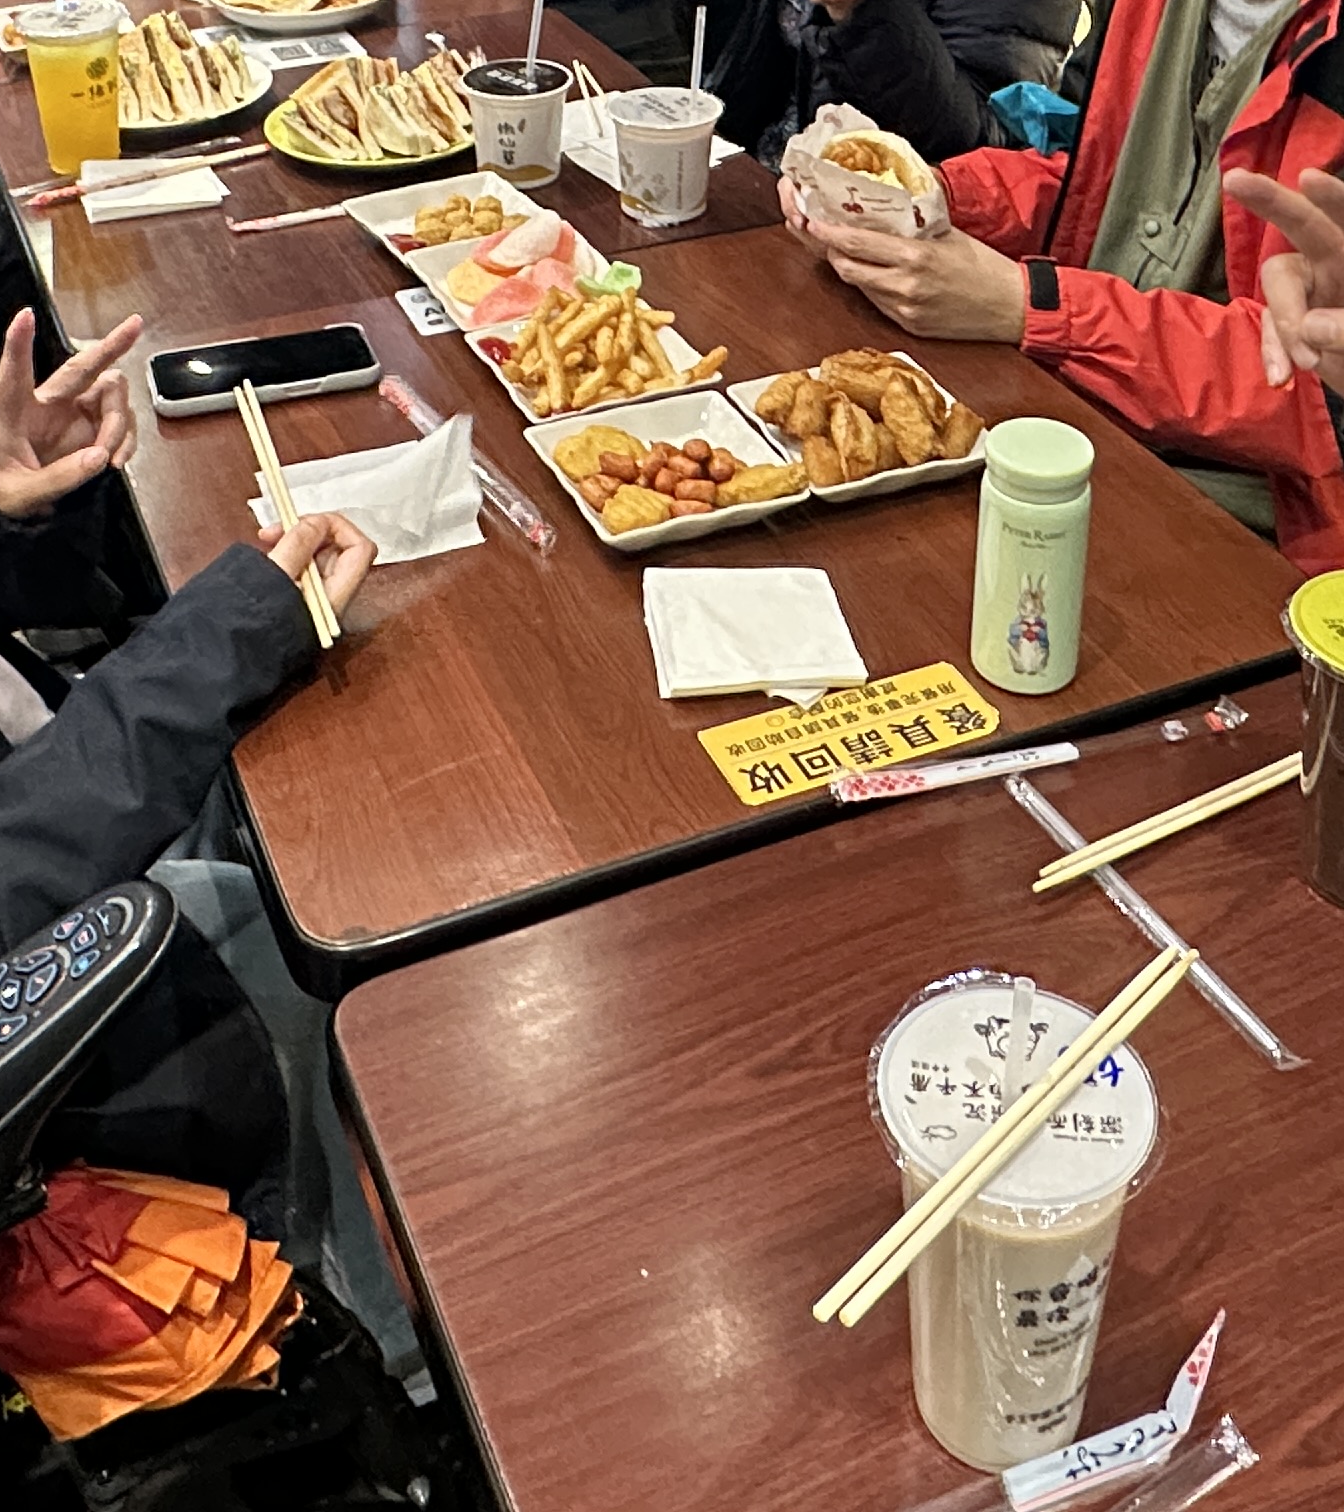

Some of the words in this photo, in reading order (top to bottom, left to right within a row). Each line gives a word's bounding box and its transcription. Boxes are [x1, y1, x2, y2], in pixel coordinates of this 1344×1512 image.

[738, 702, 987, 795] 餐具請回收
